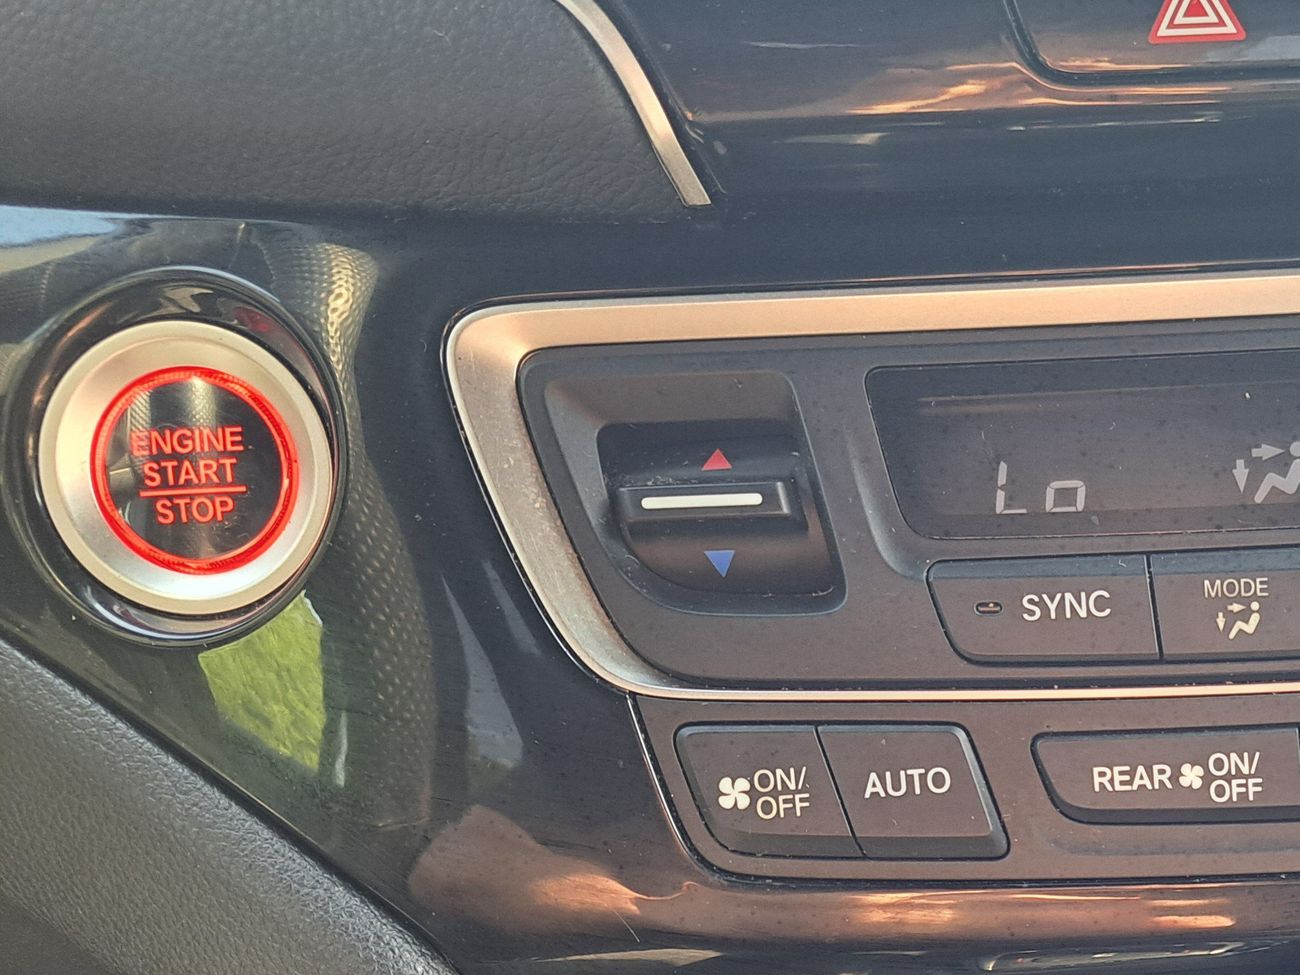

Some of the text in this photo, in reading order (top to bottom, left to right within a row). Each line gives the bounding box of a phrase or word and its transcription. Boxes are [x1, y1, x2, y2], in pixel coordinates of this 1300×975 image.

[131, 426, 243, 455] ENGINE
[142, 458, 238, 488] START
[994, 460, 1087, 515] Lo
[155, 496, 234, 524] STOP
[1202, 577, 1269, 600] MODE
[1020, 590, 1112, 622] SYNC
[753, 767, 807, 796] ON/
[863, 767, 952, 799] AUTO
[1091, 750, 1261, 793] REAR ON/
[1208, 776, 1264, 804] OFF
[755, 792, 812, 821] OFF
